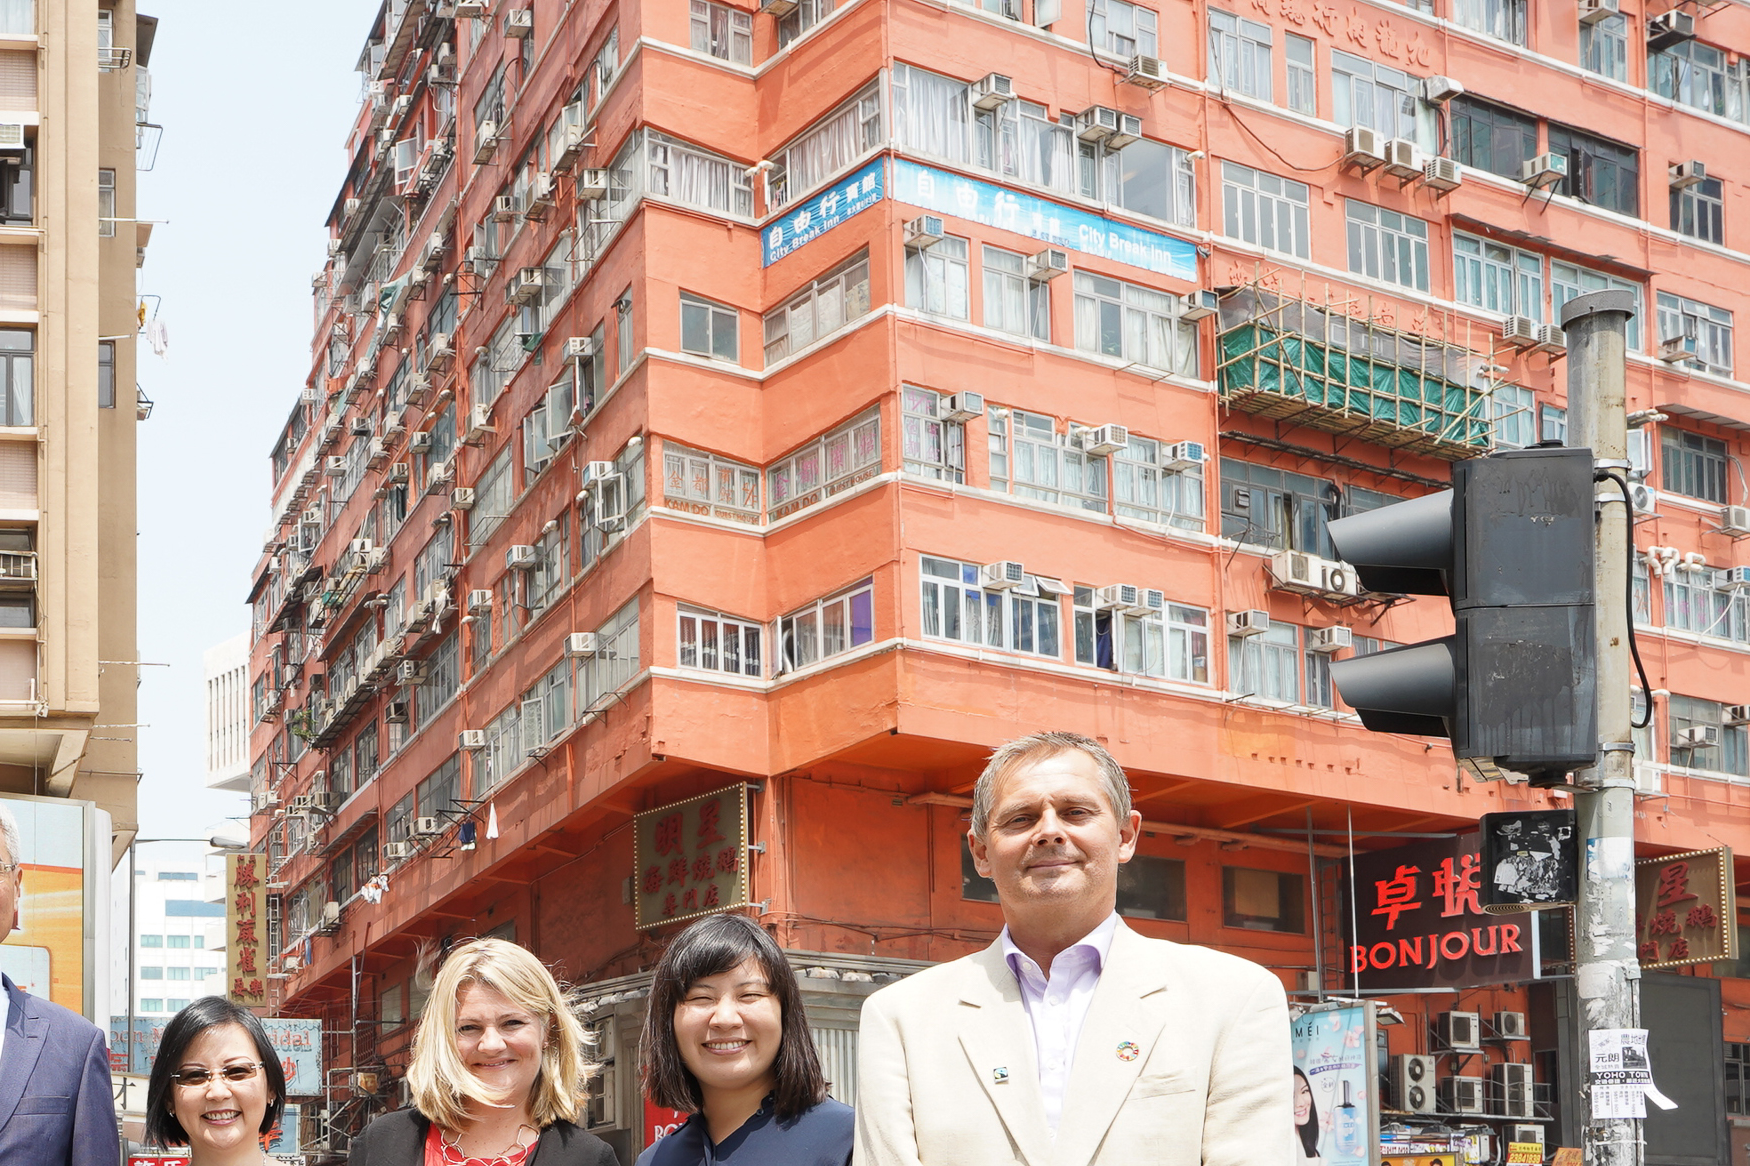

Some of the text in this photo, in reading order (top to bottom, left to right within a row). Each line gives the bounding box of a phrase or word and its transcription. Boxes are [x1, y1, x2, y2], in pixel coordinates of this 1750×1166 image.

[916, 170, 1021, 231] 自由行
[791, 225, 822, 250] Break
[823, 215, 841, 230] Inn
[1078, 223, 1106, 247] City
[1109, 232, 1148, 257] Break
[1151, 243, 1172, 265] Inn
[664, 499, 690, 513] KAM
[692, 503, 709, 516] DO
[776, 502, 800, 519] KAM
[802, 493, 819, 509] DO
[1350, 923, 1524, 974] BONJOUR
[1595, 1053, 1620, 1063] 元朗
[1596, 1071, 1626, 1080] YOHO
